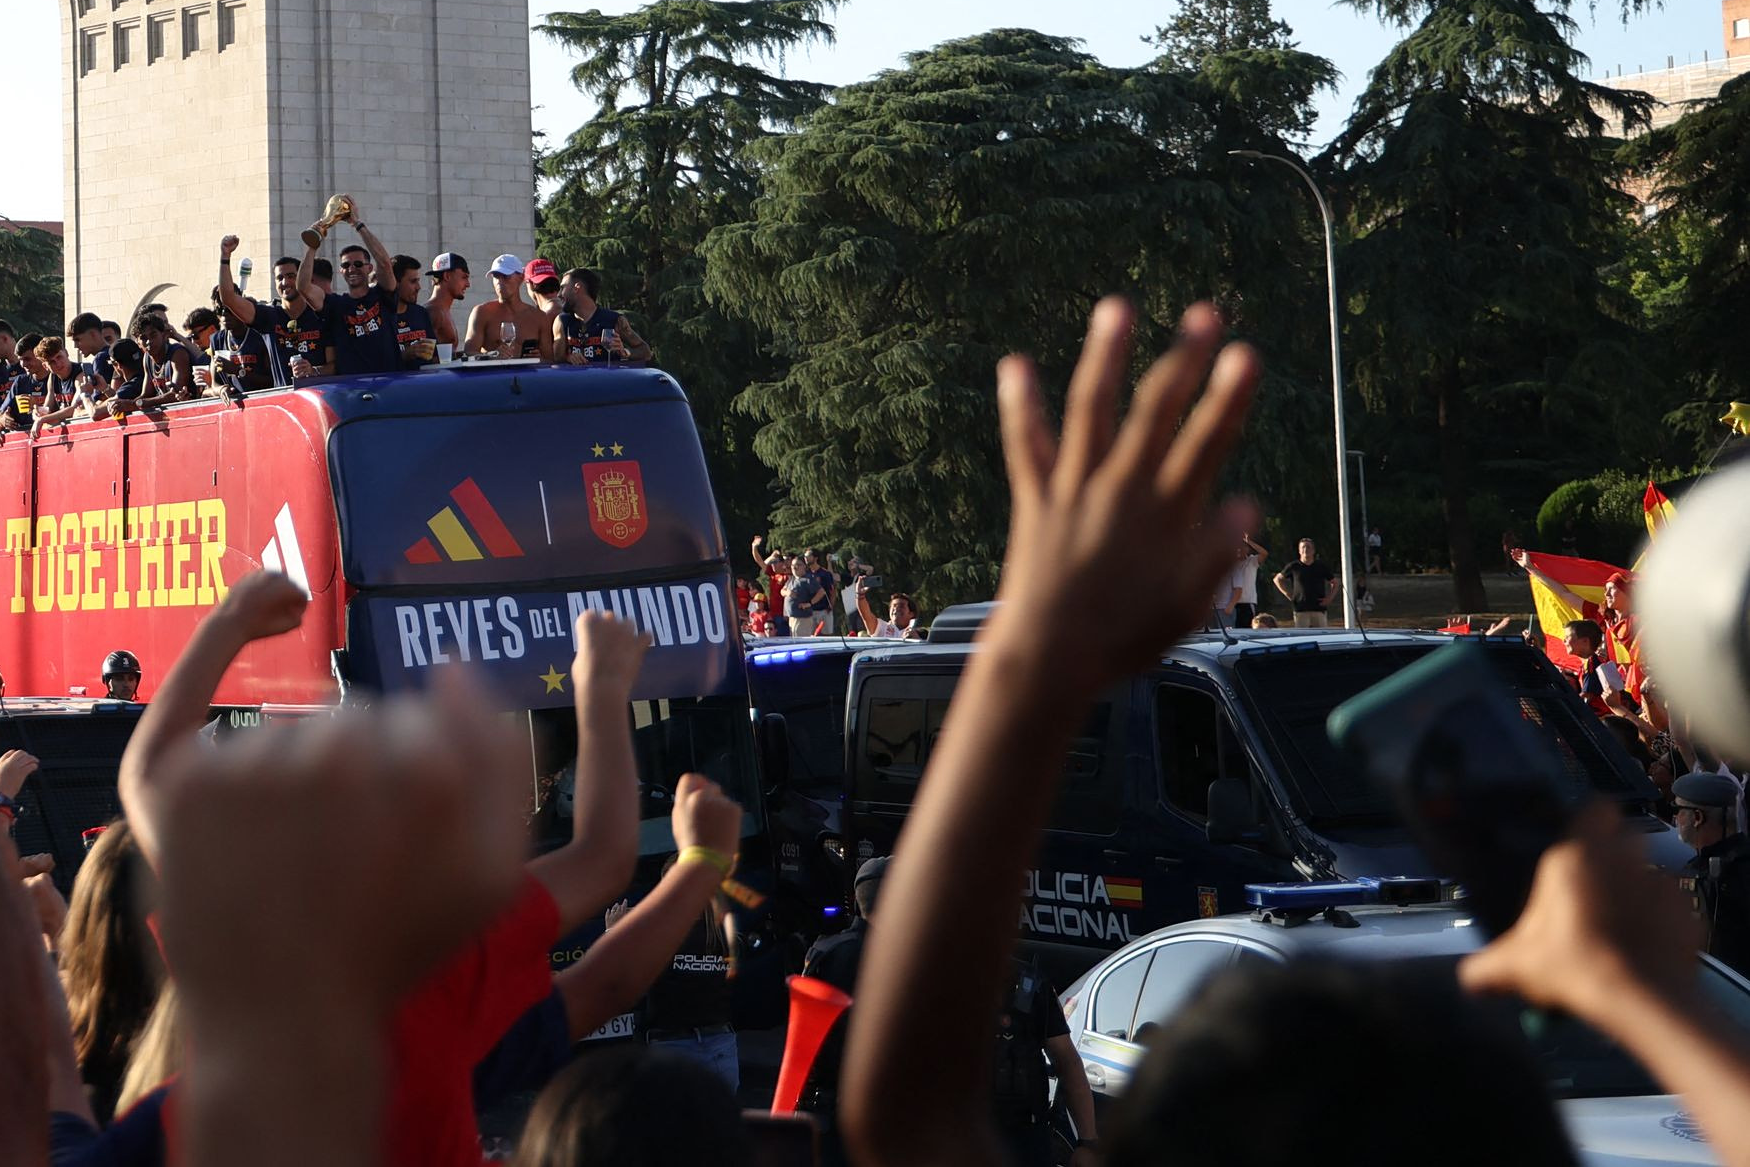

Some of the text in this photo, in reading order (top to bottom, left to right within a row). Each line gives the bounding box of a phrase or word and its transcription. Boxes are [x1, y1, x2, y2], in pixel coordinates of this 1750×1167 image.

[9, 498, 229, 613] TOGETHER
[395, 595, 526, 668] REYES
[528, 606, 566, 639] DEL
[1018, 903, 1142, 943] ACIONAL
